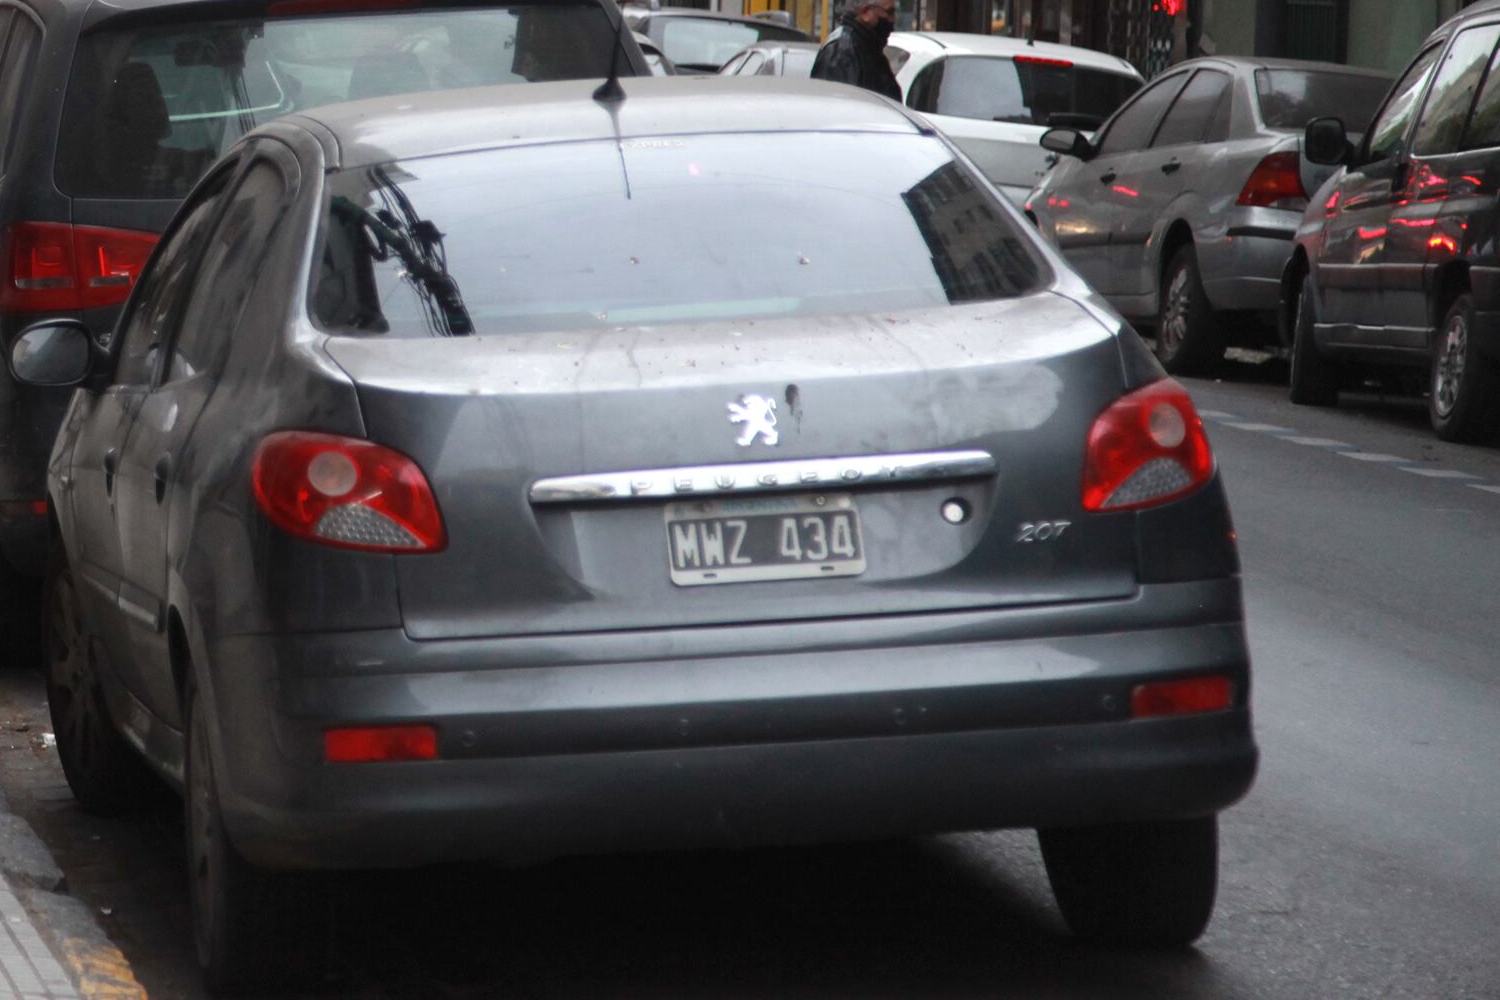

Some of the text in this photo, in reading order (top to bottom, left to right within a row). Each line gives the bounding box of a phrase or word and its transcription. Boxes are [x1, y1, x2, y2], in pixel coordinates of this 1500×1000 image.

[673, 514, 855, 568] MWZ 434
[1017, 521, 1072, 542] 207
